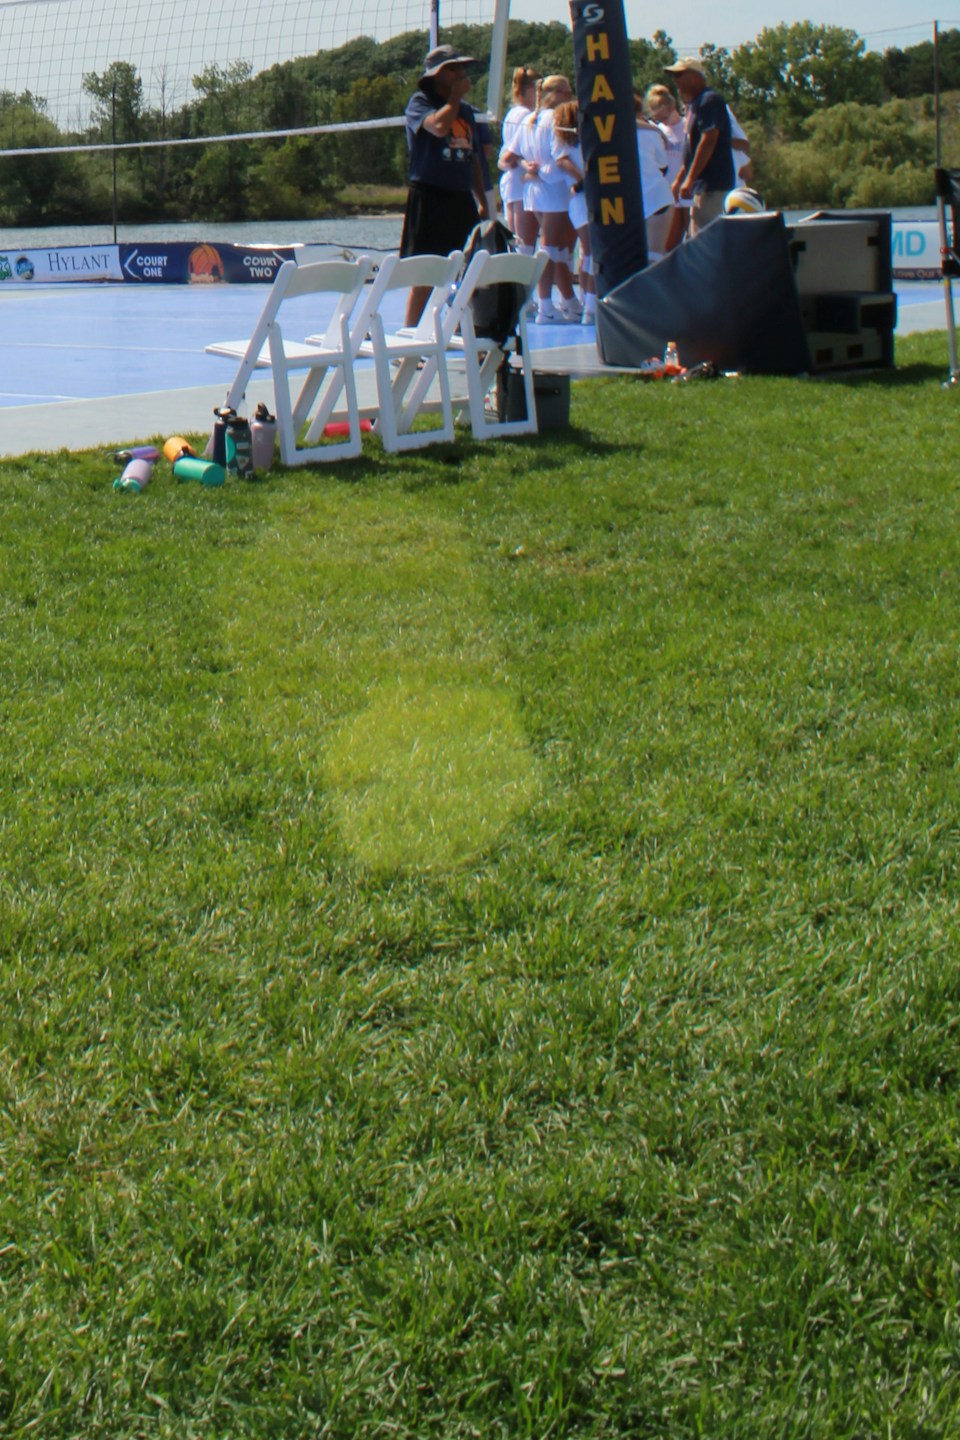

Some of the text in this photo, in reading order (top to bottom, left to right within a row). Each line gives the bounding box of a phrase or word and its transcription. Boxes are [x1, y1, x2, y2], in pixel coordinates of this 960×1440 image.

[586, 32, 625, 226] HAVEN
[136, 256, 168, 267] COURT
[243, 256, 278, 267] COURT
[143, 267, 163, 277] ONE
[249, 267, 273, 277] TWO
